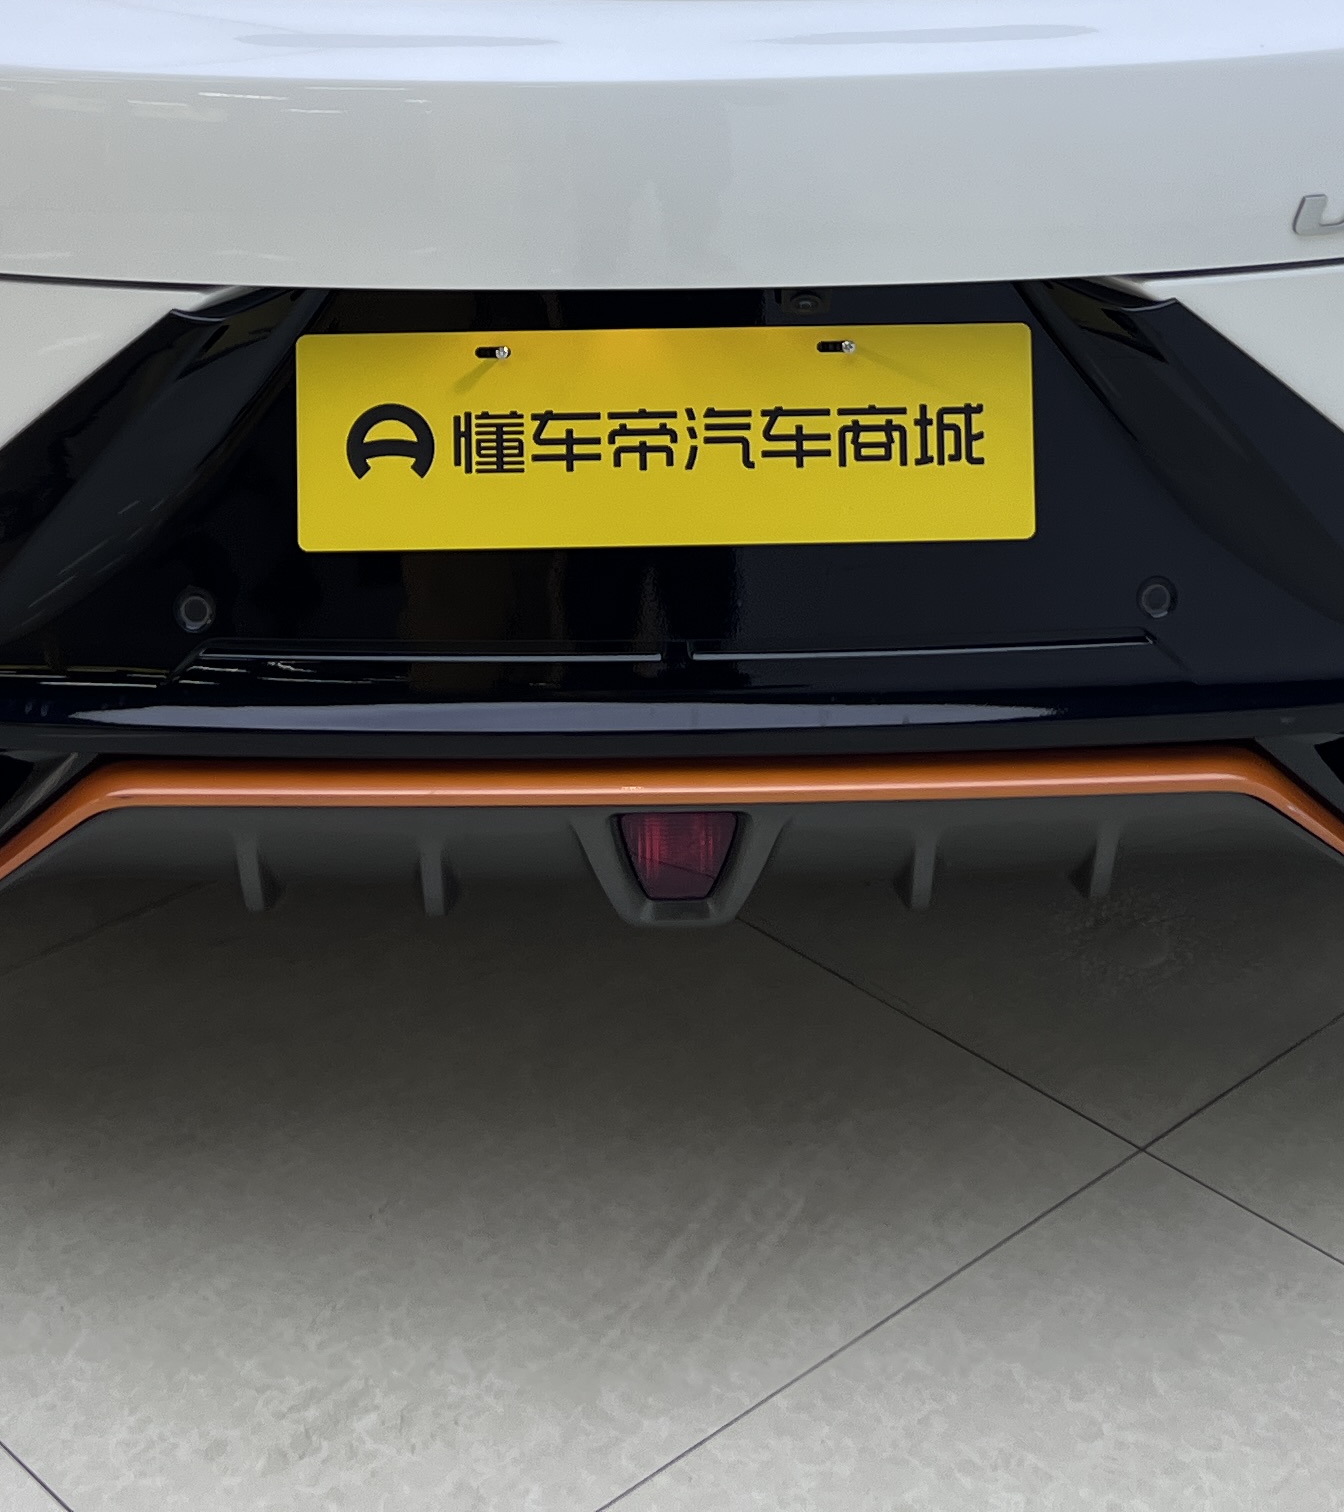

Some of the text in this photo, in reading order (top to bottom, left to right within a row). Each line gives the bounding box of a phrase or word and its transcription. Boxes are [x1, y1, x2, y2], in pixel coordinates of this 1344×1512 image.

[453, 402, 986, 475] 懂车帝汽车商城
